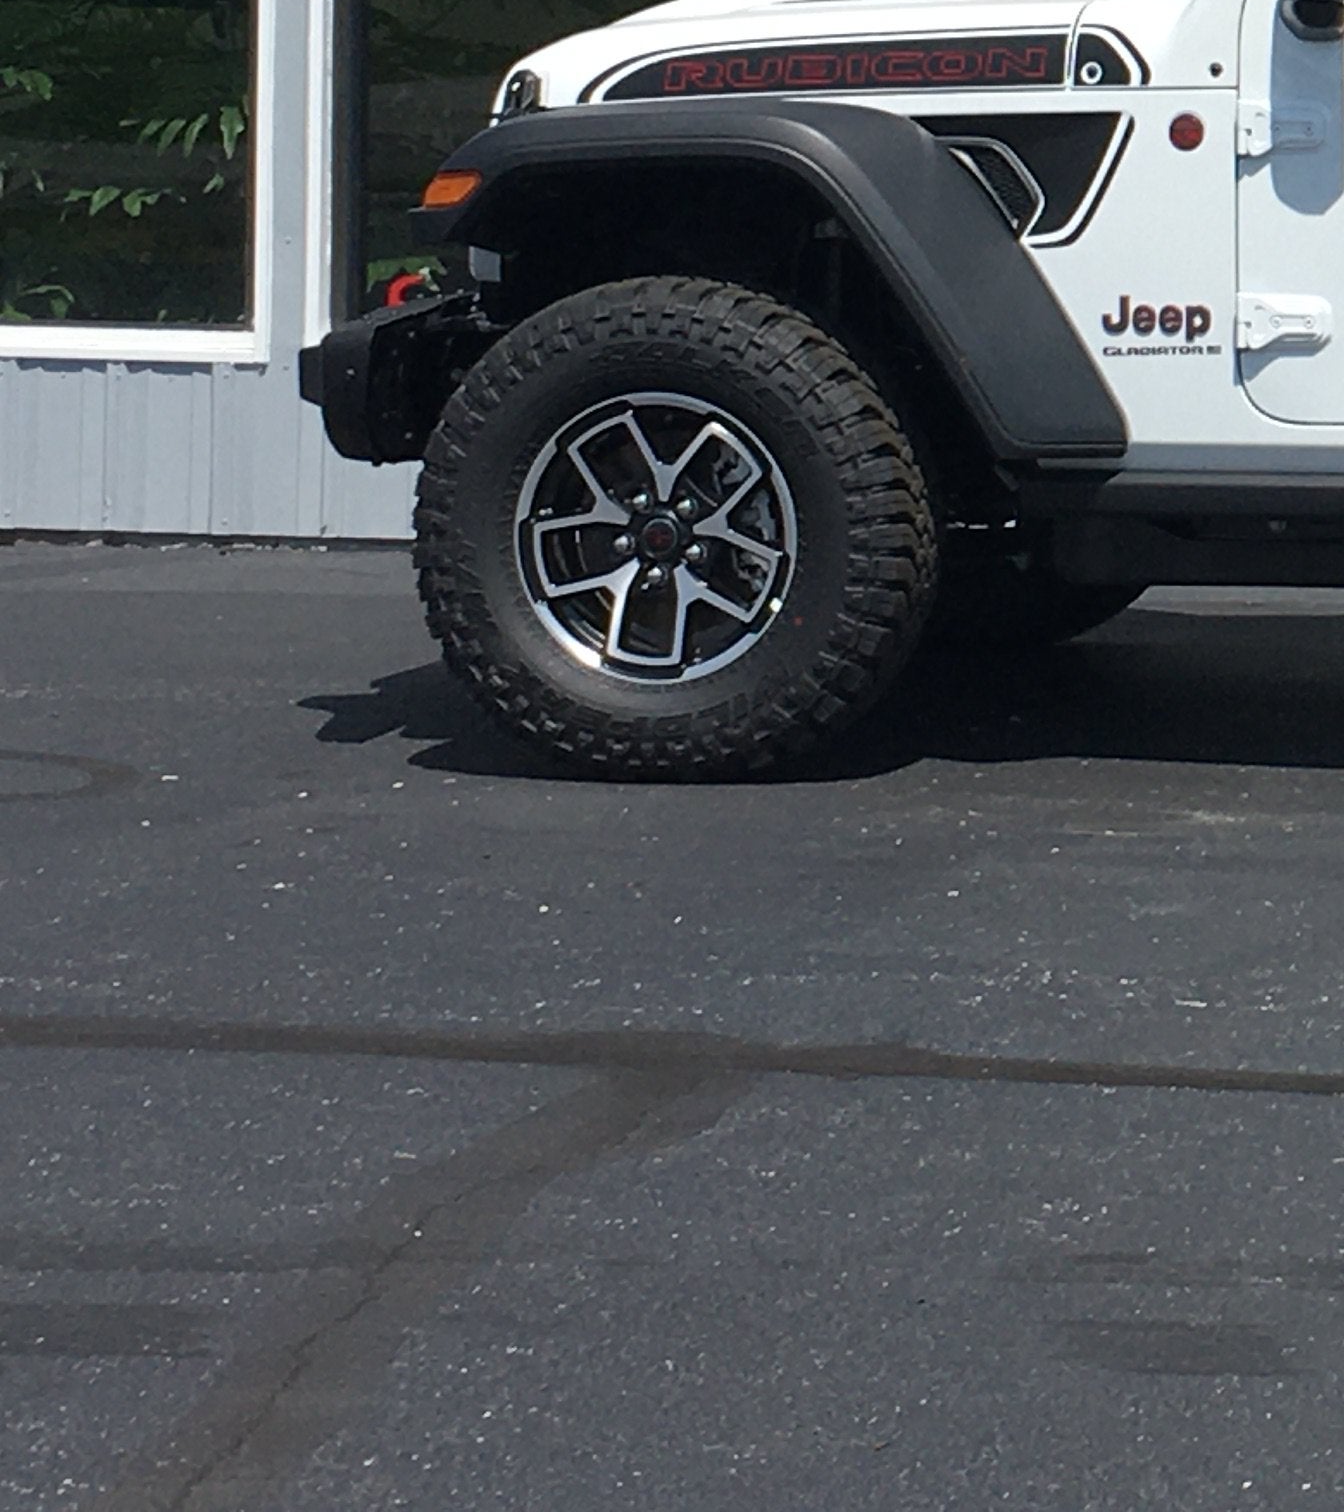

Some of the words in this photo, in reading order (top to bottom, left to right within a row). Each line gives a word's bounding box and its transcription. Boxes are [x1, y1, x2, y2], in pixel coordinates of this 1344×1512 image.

[664, 46, 1049, 92] RUBICON
[1102, 294, 1212, 343] Jeep
[1102, 345, 1204, 357] GLADIATOR
